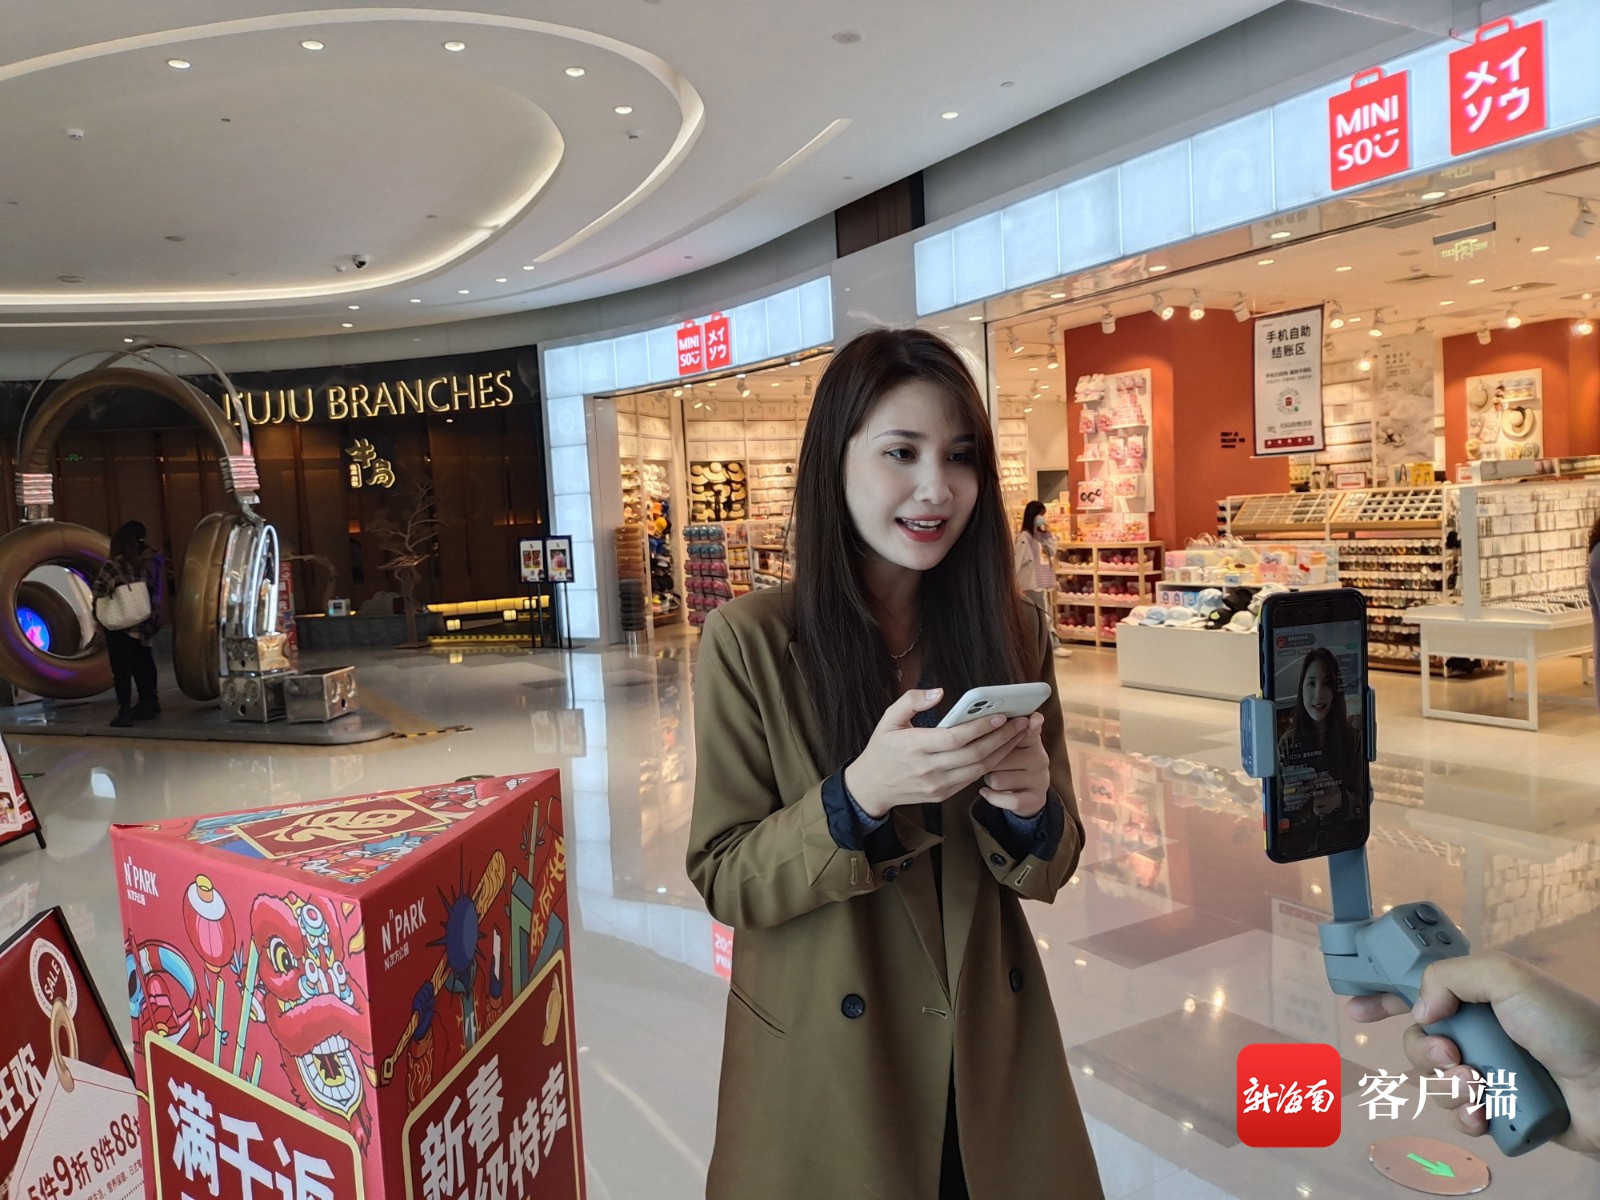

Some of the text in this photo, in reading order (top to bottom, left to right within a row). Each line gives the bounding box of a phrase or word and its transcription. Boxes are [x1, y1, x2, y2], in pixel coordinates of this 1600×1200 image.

[1462, 46, 1527, 99] メイ
[1336, 95, 1399, 139] MINI
[1465, 86, 1530, 134] ソウ
[679, 335, 700, 351] MINI
[708, 326, 725, 346] メイ
[709, 344, 727, 361] ソウ
[1266, 324, 1311, 343] 手机自助
[327, 369, 514, 420] BRANCHES
[44, 959, 61, 1000] SALE
[420, 1054, 504, 1200] 新春
[457, 1061, 568, 1200] 级特卖
